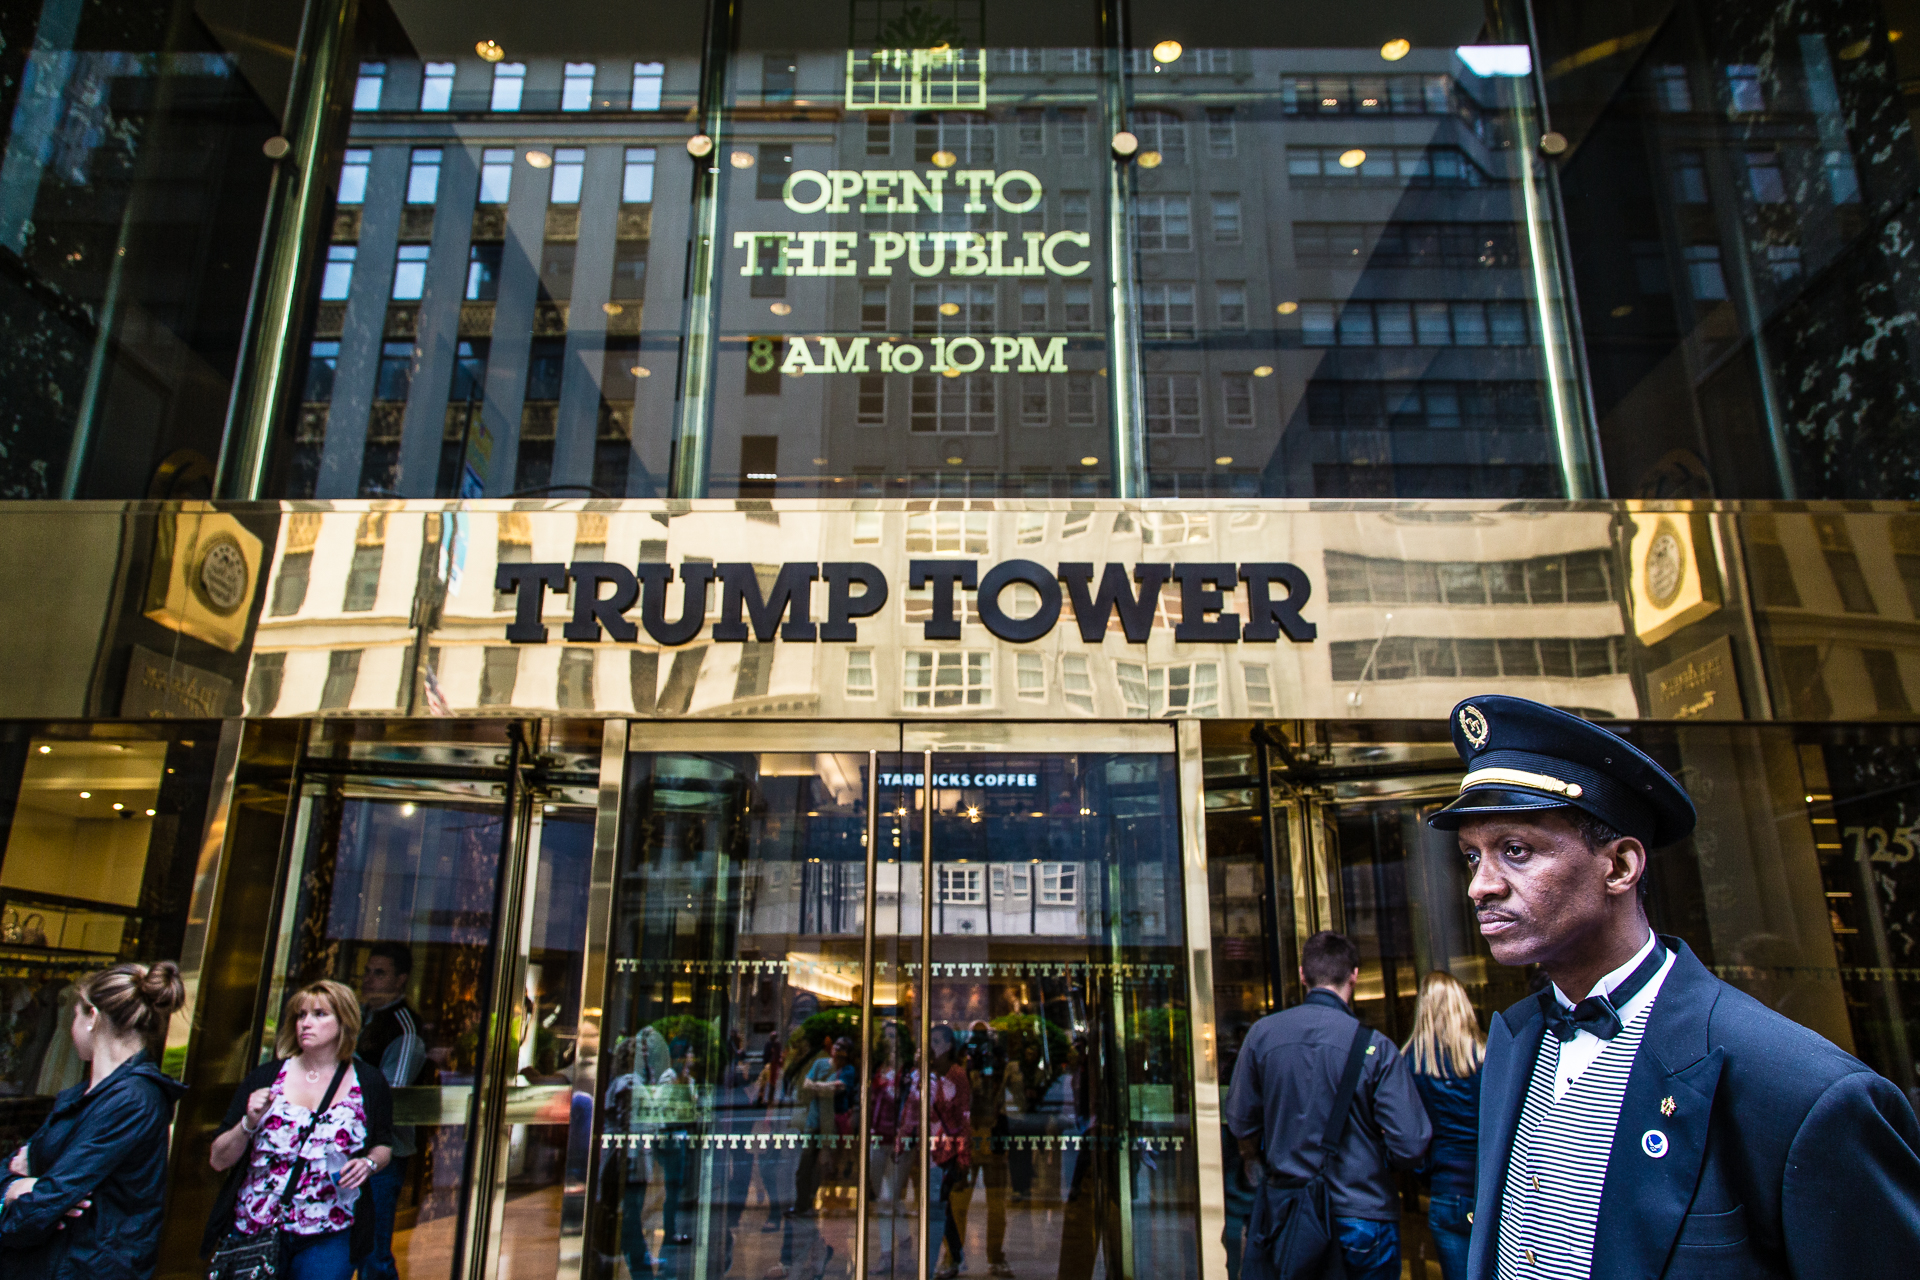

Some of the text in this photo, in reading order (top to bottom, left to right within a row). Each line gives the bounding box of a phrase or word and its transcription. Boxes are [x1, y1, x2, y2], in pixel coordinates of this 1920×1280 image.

[782, 169, 1043, 213] OPEN TO
[733, 230, 1091, 276] THE PUBLIC
[877, 340, 924, 374] to
[990, 337, 1068, 373] PM
[494, 558, 1318, 646] TRUMP TOWER
[878, 773, 1038, 787] TARBCKS COFFEE
[1843, 826, 1915, 863] 725
